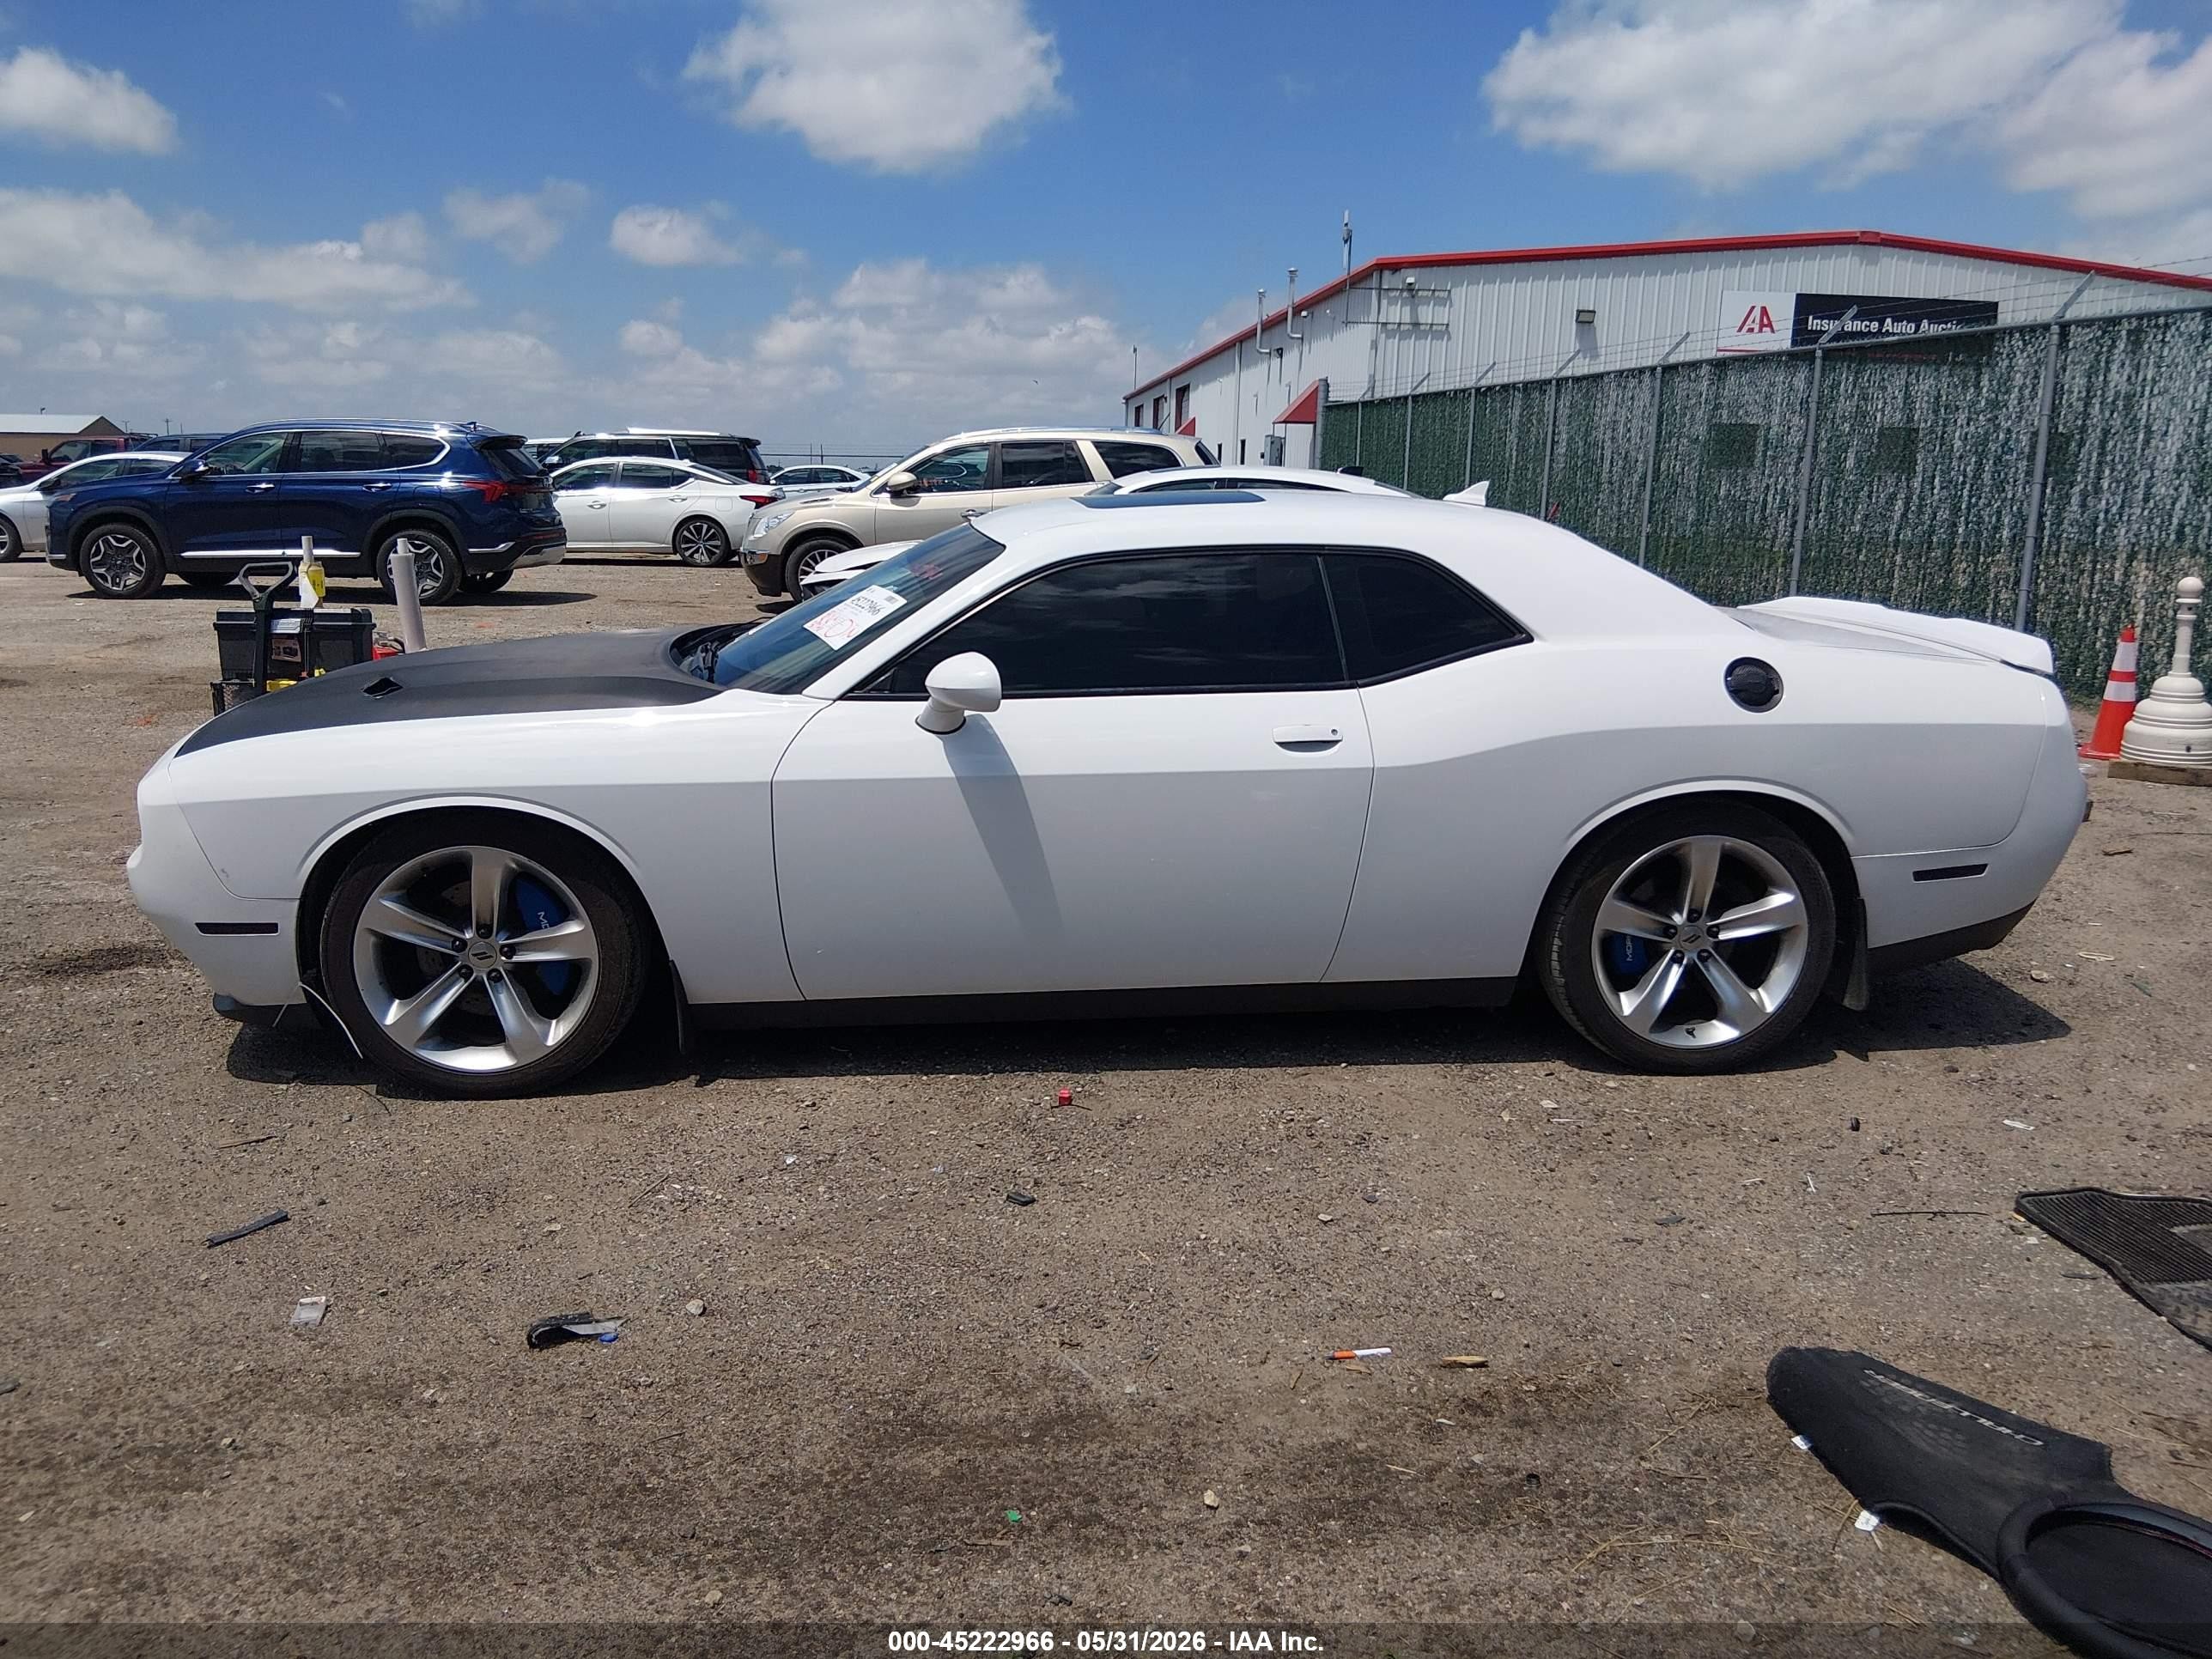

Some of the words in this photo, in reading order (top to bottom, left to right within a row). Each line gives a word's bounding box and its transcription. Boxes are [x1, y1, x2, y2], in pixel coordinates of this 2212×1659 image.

[1808, 315, 1879, 332] Insuance
[1881, 318, 1915, 333] Auto
[1863, 1370, 2045, 1446] CHALLENGER
